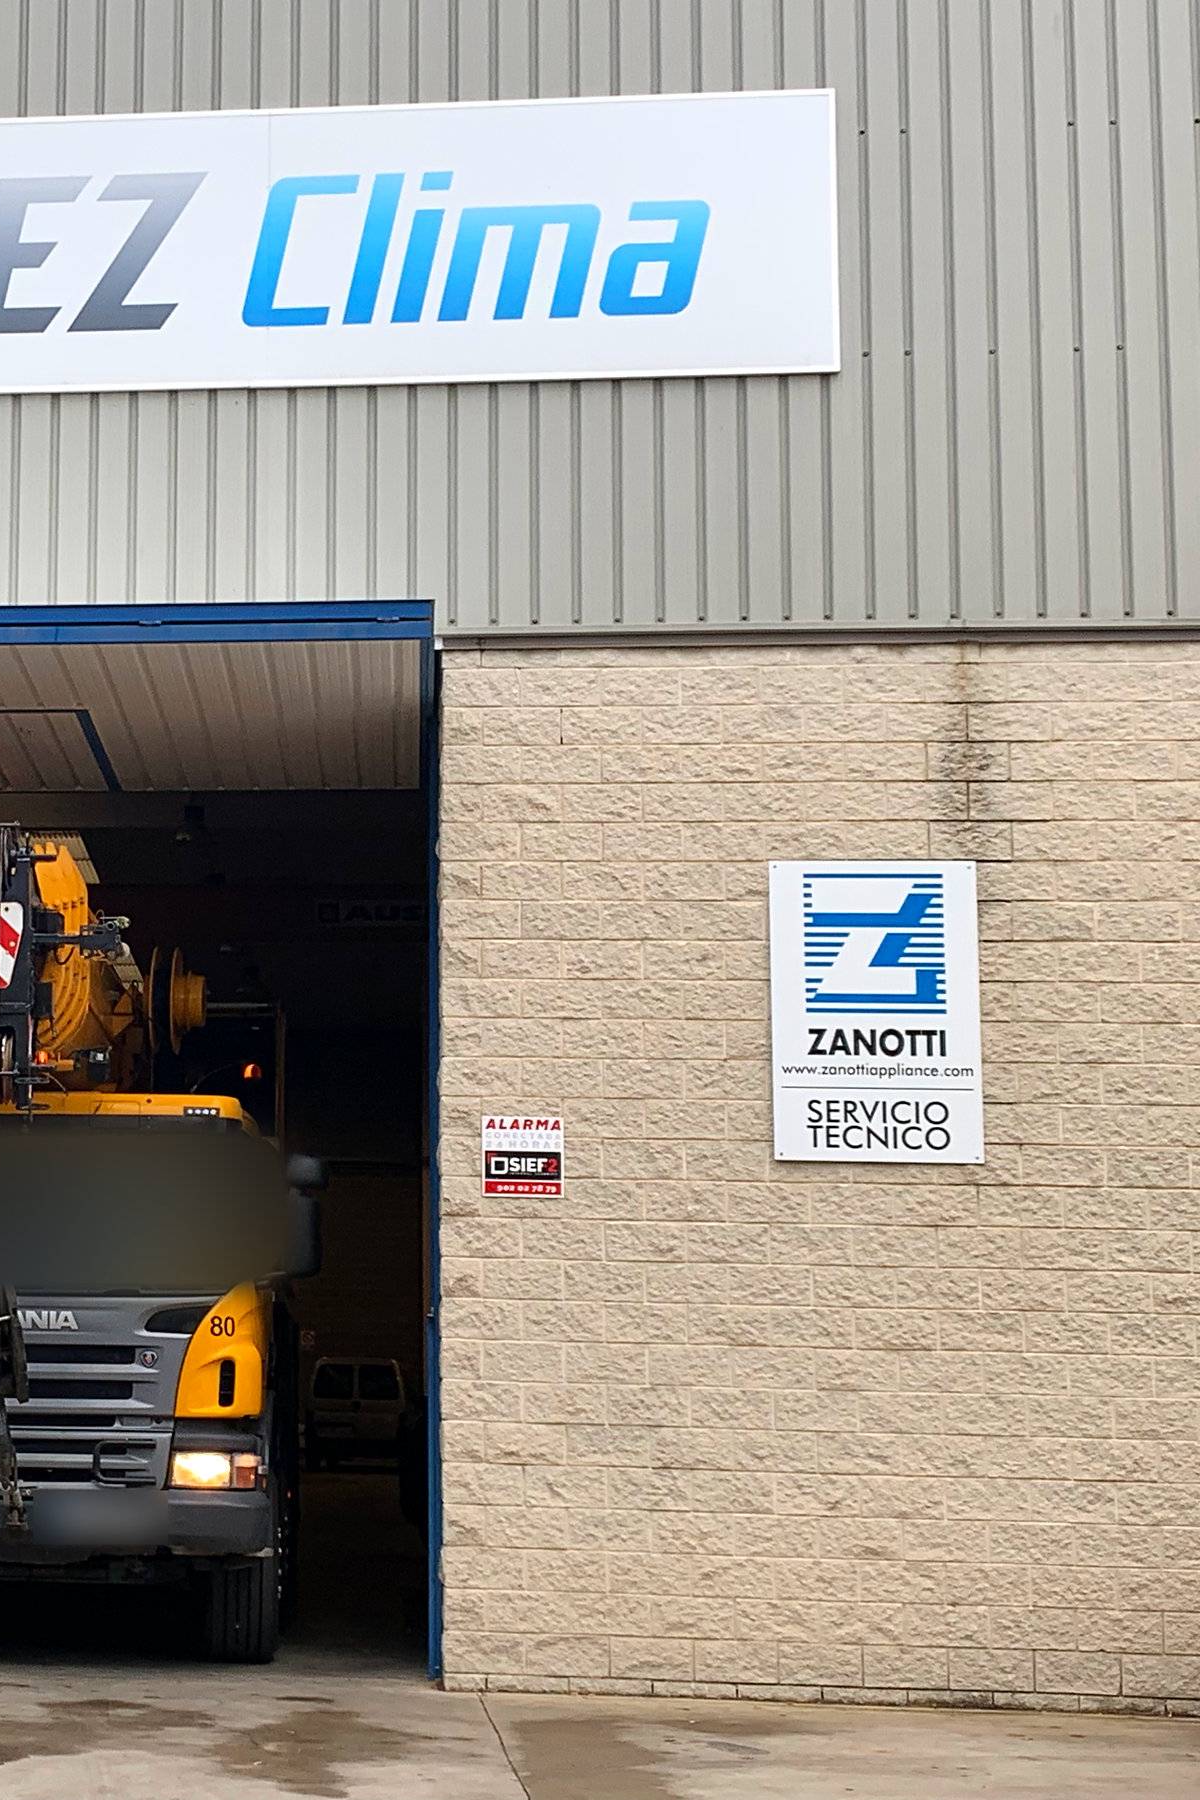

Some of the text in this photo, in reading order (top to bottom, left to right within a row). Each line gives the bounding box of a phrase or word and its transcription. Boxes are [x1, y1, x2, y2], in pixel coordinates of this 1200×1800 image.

[241, 170, 711, 328] Clima
[808, 1028, 947, 1057] ZANOTTI
[781, 1063, 974, 1079] www.zanottiappliance.com
[485, 1118, 561, 1130] ALARMA
[807, 1099, 949, 1125] SERVICIO
[806, 1125, 951, 1151] TECNICO
[210, 1315, 235, 1337] 80
